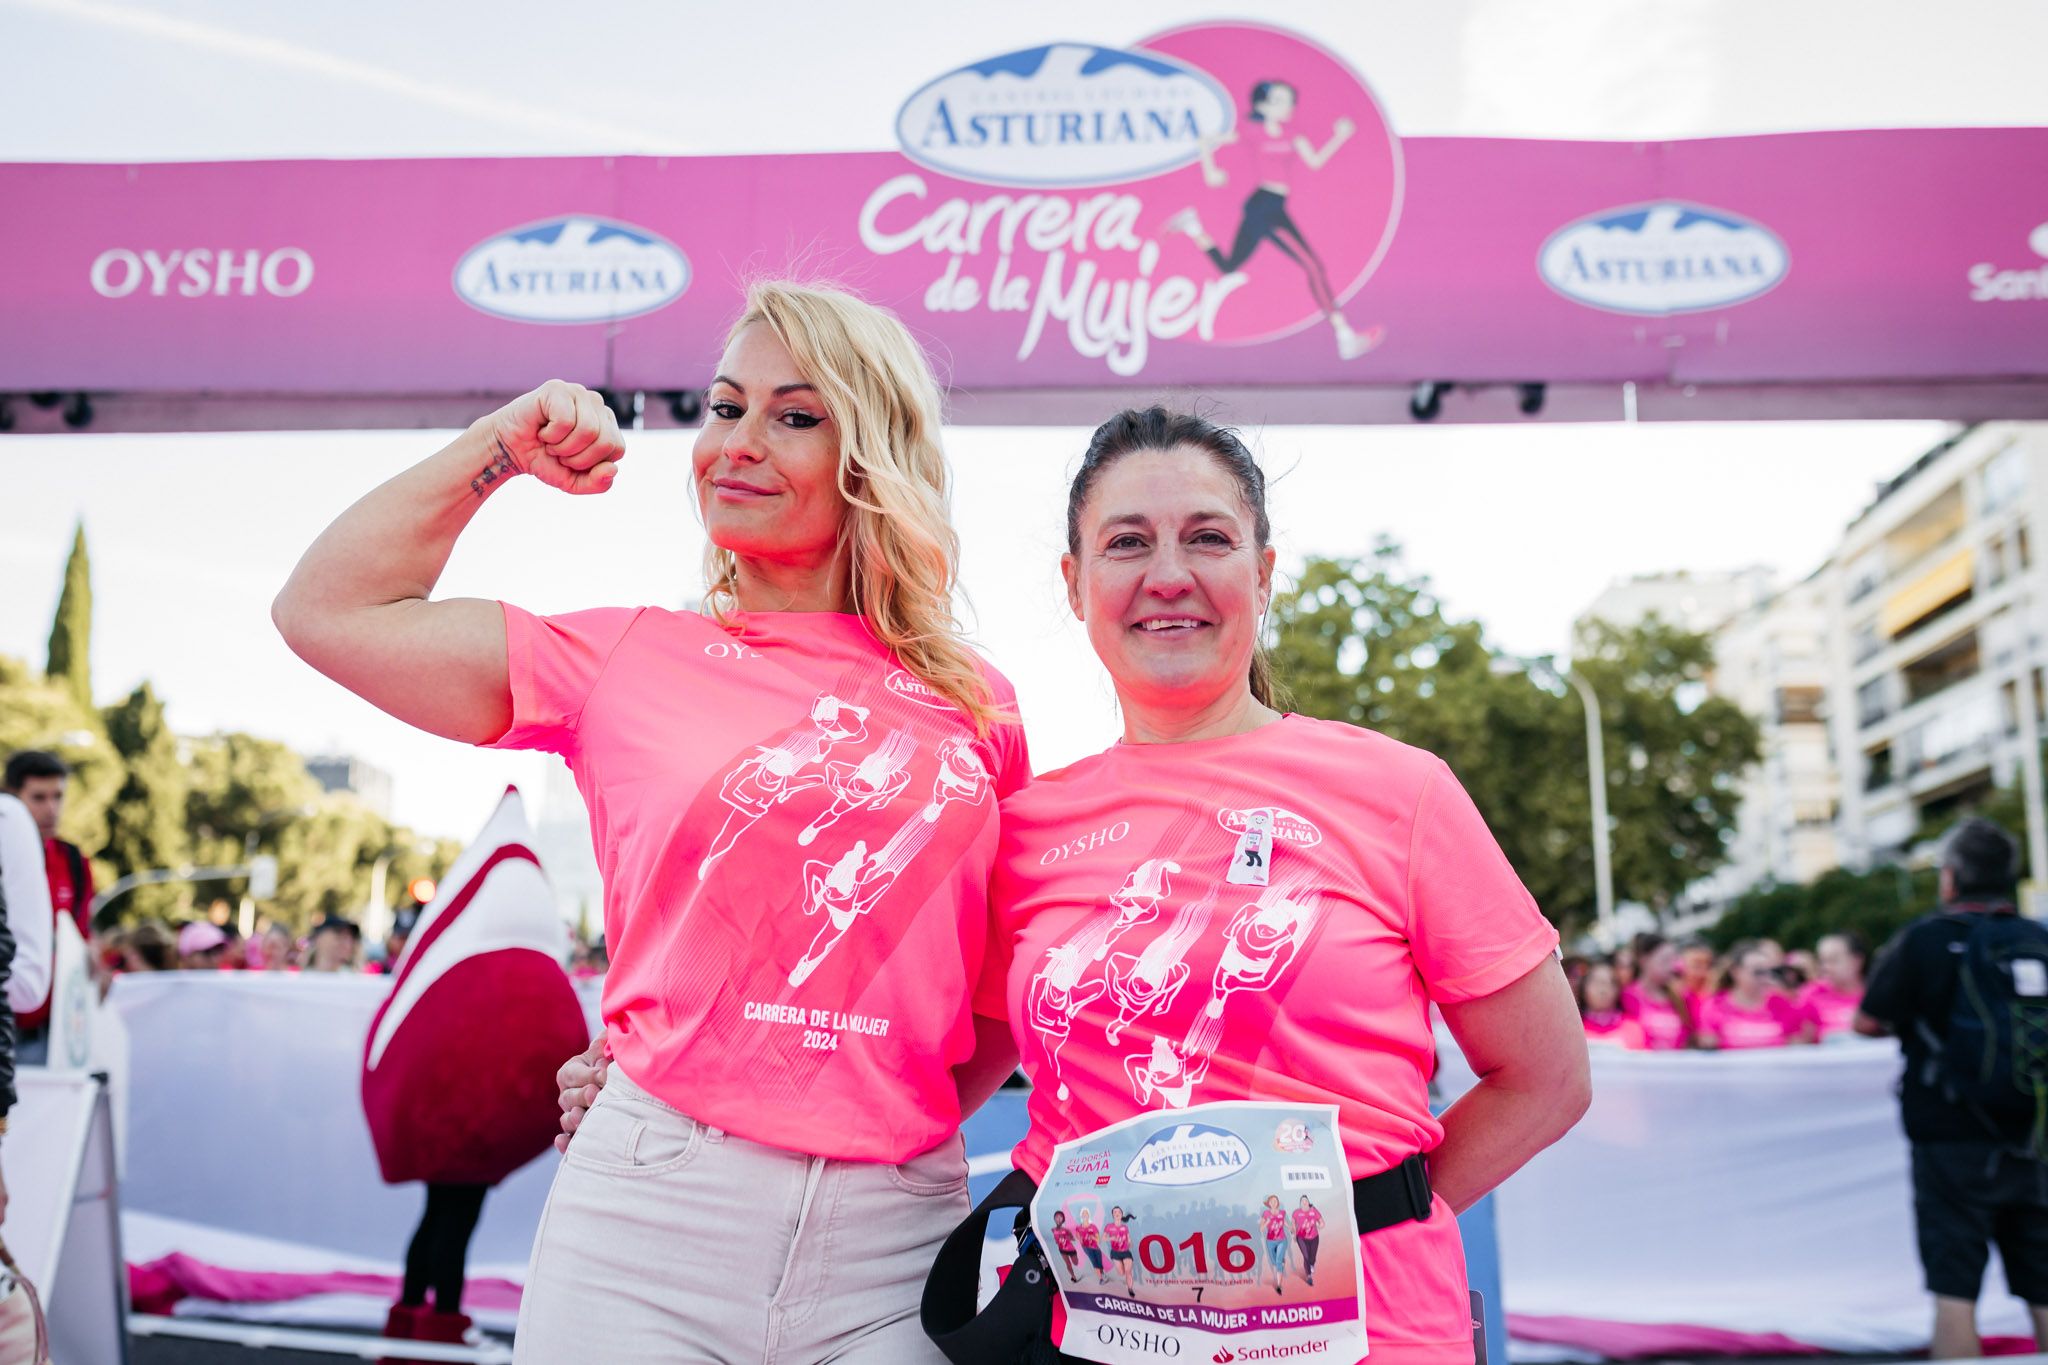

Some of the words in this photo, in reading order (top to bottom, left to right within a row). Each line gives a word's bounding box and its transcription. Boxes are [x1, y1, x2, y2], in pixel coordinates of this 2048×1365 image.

[921, 97, 1203, 146] ASTURIANA
[858, 174, 1143, 254] Carrera
[90, 247, 314, 298] OYSHO
[472, 252, 668, 295] ASTURIANA
[924, 255, 982, 313] de
[987, 255, 1031, 312] la
[1563, 246, 1768, 284] ASTURIANA
[1016, 240, 1249, 377] Mujer
[1040, 821, 1130, 866] OYSHO
[744, 1001, 807, 1026] CARRERA
[810, 1009, 830, 1029] DE
[832, 1012, 848, 1031] LA
[849, 1014, 890, 1037] MUJER
[802, 1030, 838, 1051] 2024
[1065, 1159, 1110, 1174] SUMA
[1132, 1150, 1243, 1178] ASTURIANA
[1138, 1229, 1256, 1274] 016
[1095, 1297, 1155, 1318] CARRERA
[1157, 1308, 1176, 1322] DE
[1178, 1309, 1198, 1323] LA
[1200, 1309, 1248, 1329] MUJER
[1261, 1305, 1323, 1324] MADRID
[1192, 1286, 1204, 1303] 7
[1097, 1323, 1181, 1358] OYSHO
[1237, 1339, 1330, 1361] Santander
